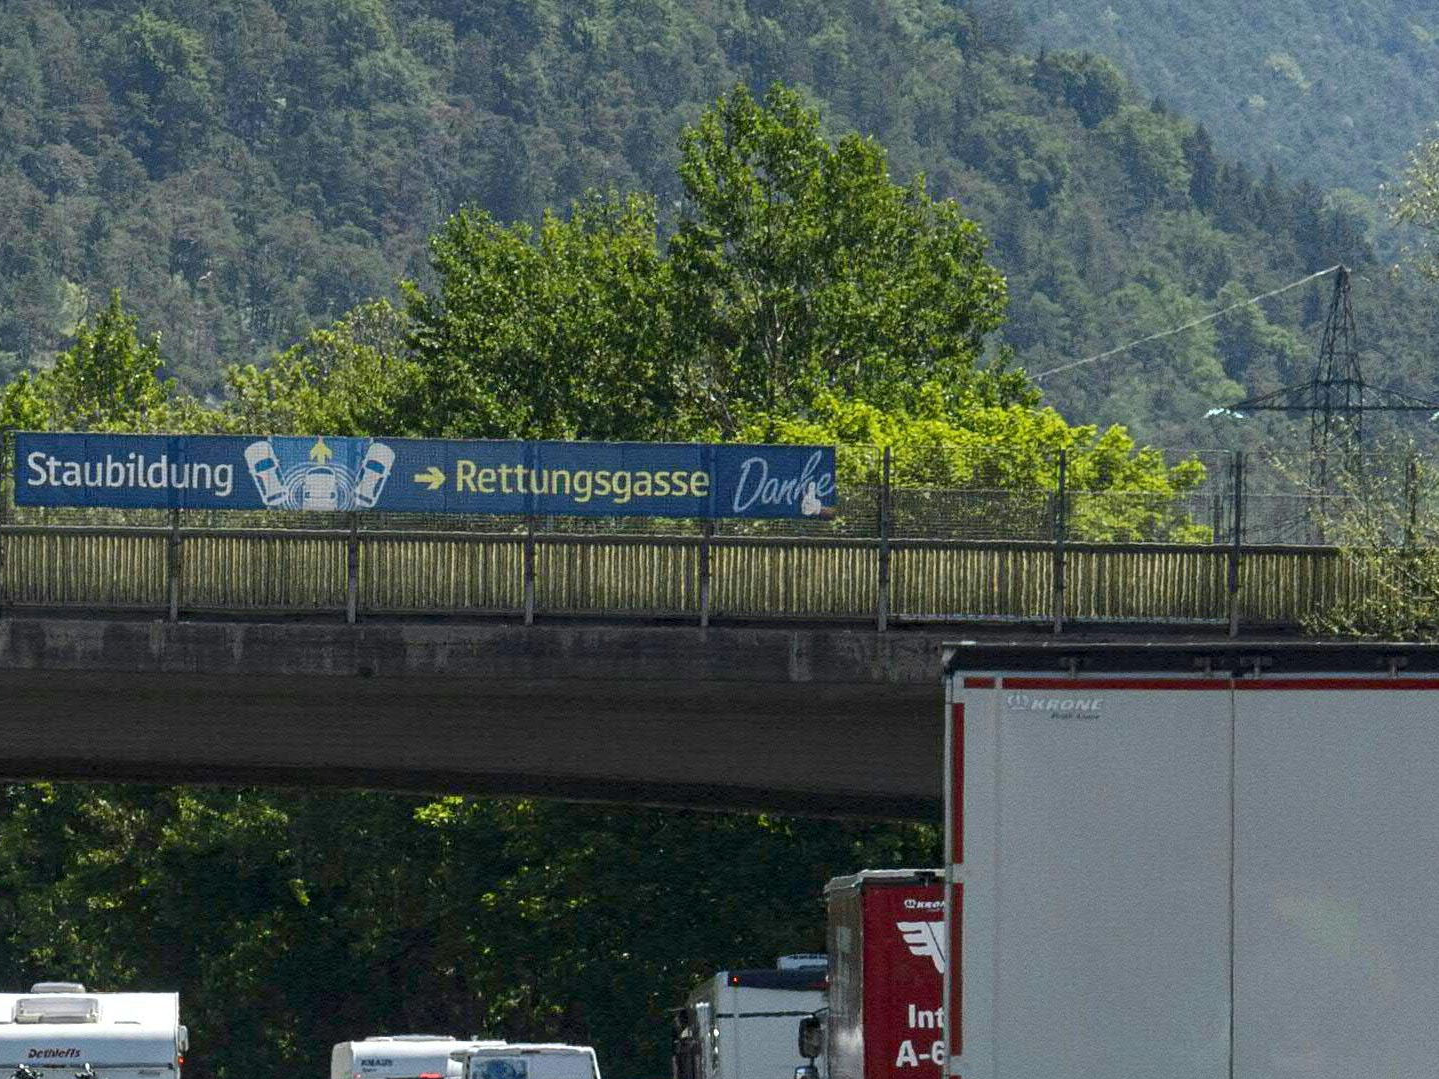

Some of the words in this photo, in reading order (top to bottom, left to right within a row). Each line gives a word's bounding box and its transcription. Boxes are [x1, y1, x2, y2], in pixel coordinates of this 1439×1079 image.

[27, 451, 234, 497] Staubildung
[456, 459, 711, 503] Rettungsgasse
[733, 450, 834, 512] Danke
[1031, 699, 1103, 710] KRONE
[28, 1048, 81, 1058] Dethleffs
